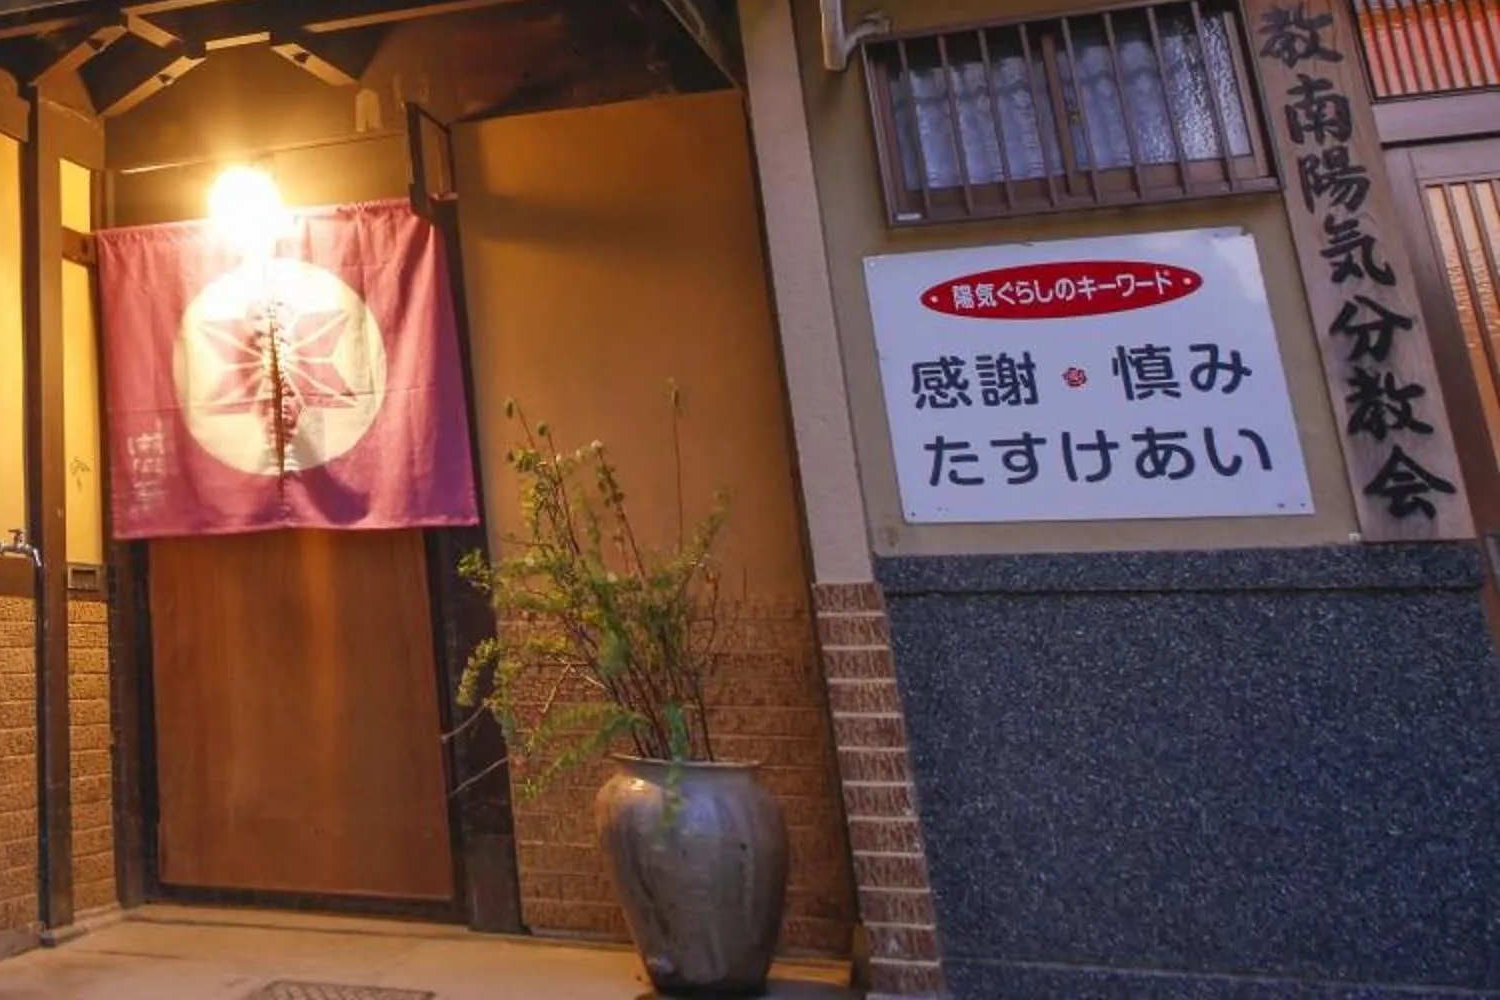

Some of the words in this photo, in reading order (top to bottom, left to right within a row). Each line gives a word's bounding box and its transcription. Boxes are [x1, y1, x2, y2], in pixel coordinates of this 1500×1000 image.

[952, 269, 1174, 309] 陽気ぐらしのキーワード
[911, 350, 1040, 410] 感謝
[1111, 343, 1253, 401] 慎み
[923, 426, 1274, 487] たすけあい
